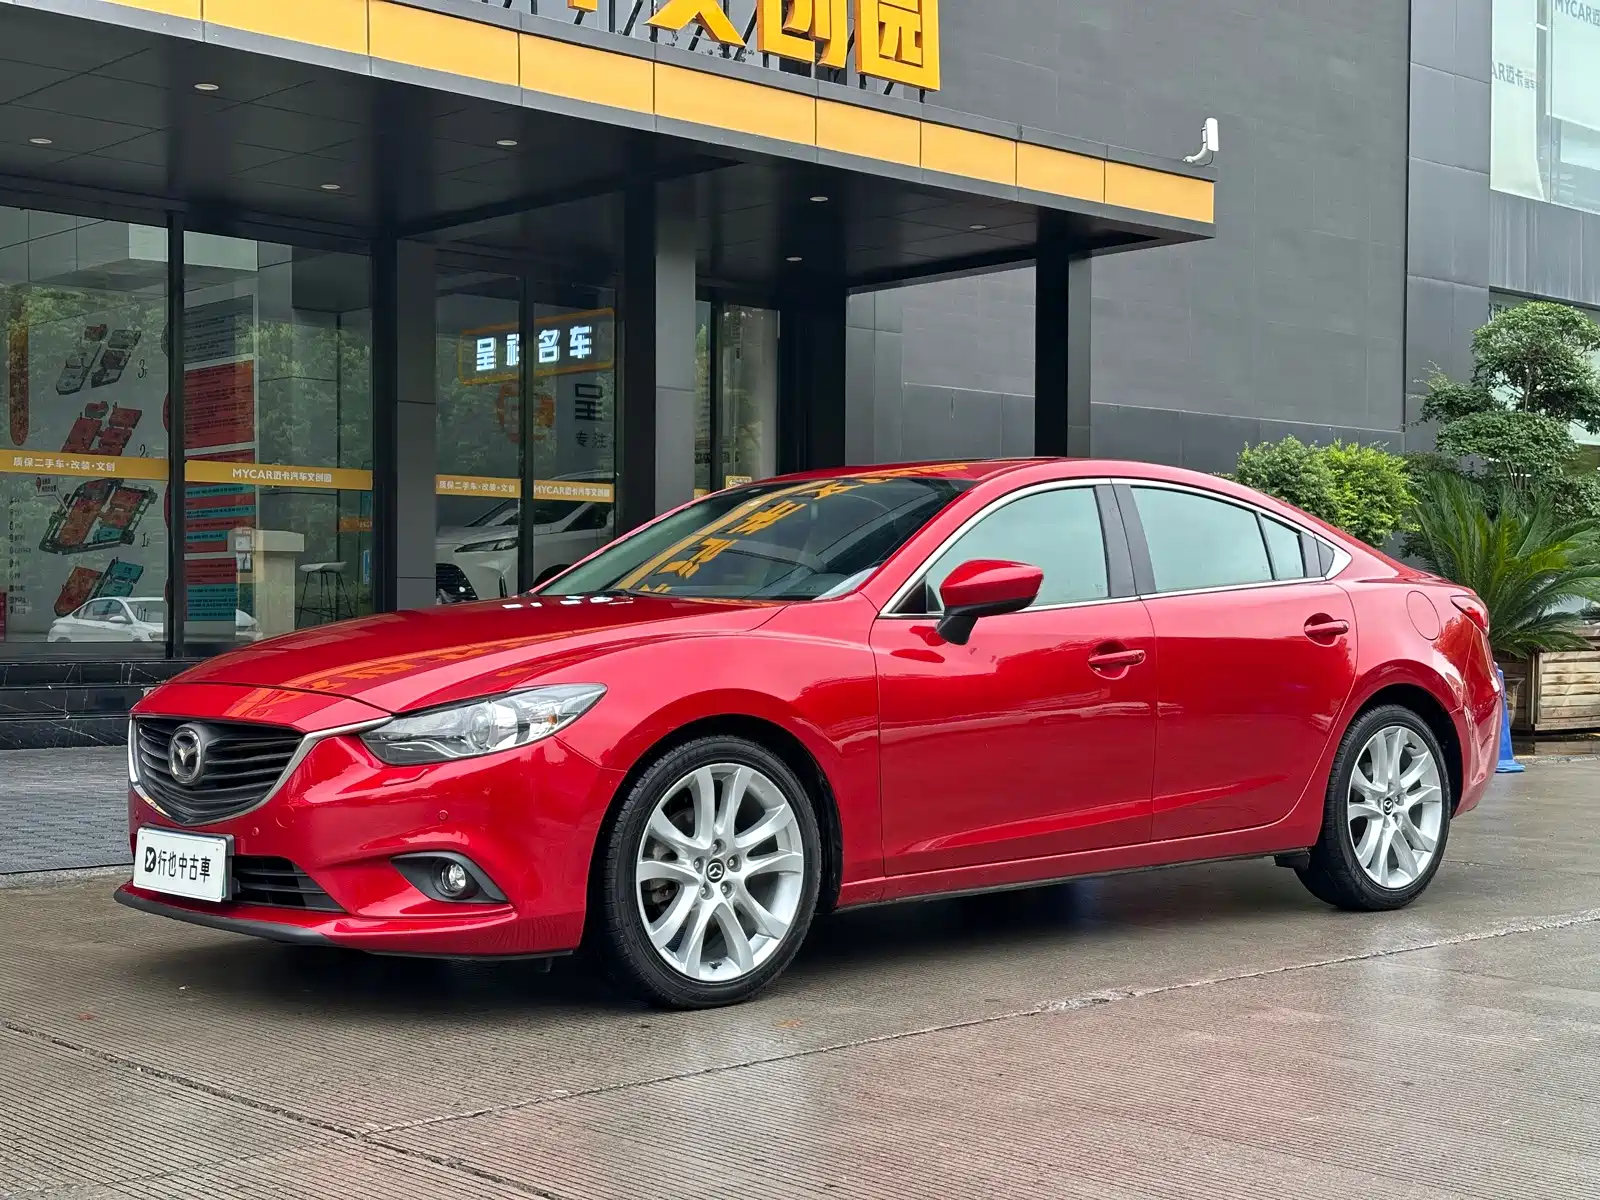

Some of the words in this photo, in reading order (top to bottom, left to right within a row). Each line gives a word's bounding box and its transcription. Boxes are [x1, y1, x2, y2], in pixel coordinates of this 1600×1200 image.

[158, 849, 211, 883] 行也中古車
